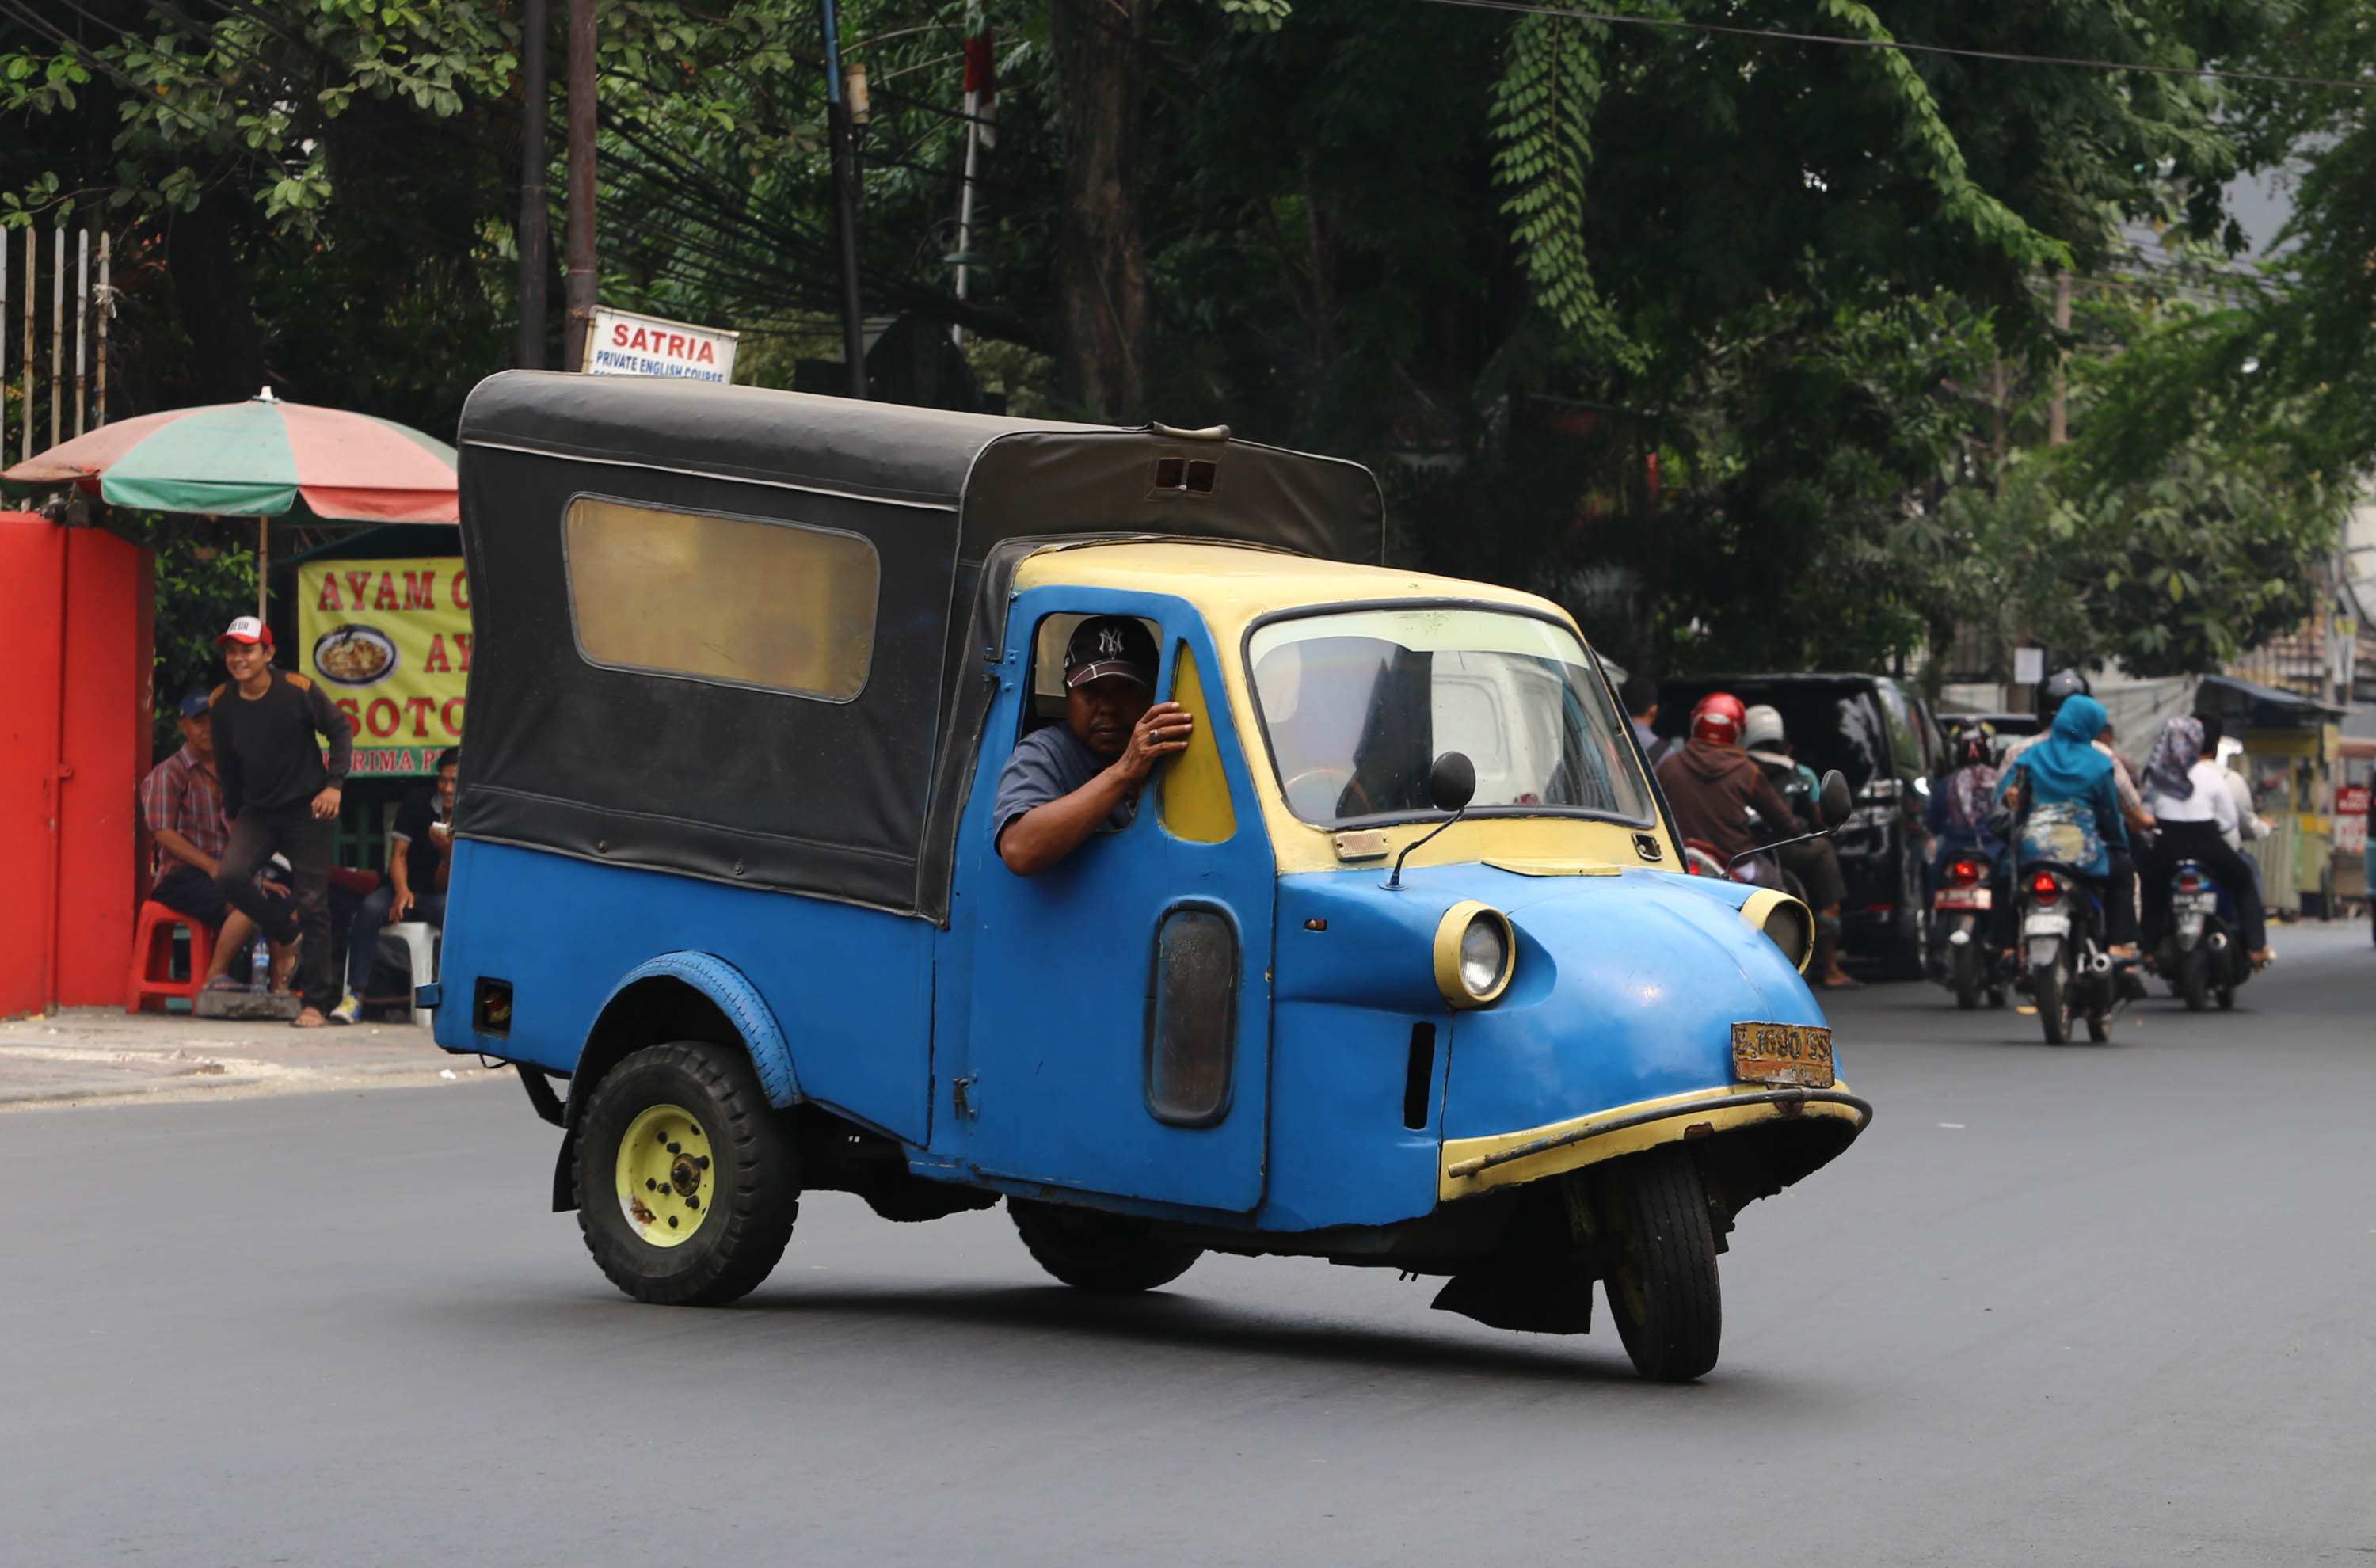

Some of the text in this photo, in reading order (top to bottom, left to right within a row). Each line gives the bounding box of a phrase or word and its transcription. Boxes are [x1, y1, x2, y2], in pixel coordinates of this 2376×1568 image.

[612, 324, 714, 364] SATRIA
[596, 350, 638, 371] PRIVATE
[639, 358, 683, 376] ENGLISH
[318, 571, 435, 611] AYAM
[425, 634, 475, 672] AY
[1099, 626, 1125, 660] NY
[336, 697, 467, 737] SOTO
[322, 749, 445, 772] RIMA P
[1807, 1031, 1830, 1061] SS
